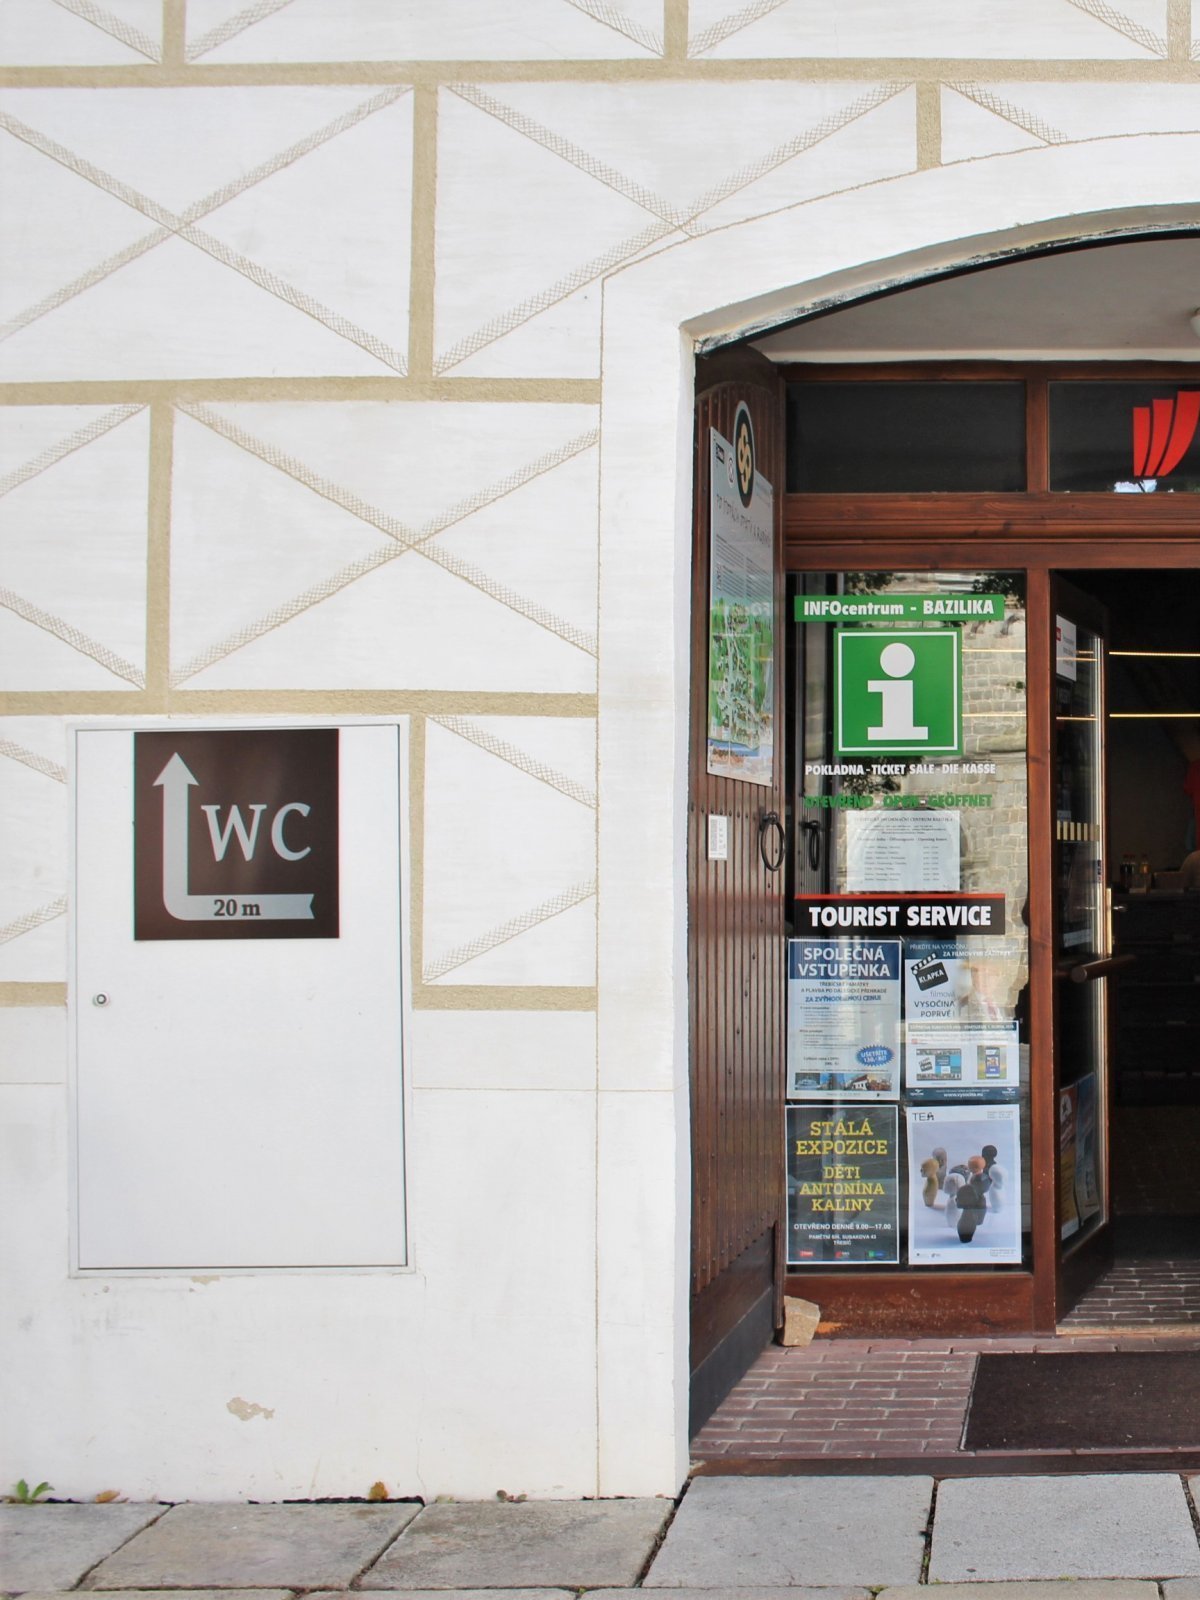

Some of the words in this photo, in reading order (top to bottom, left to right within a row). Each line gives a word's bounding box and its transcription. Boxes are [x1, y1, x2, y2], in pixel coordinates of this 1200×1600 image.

[804, 600, 904, 615] INFOcentrum
[923, 600, 994, 614] BAZILIKA
[805, 764, 864, 776] POKLADNA
[871, 764, 906, 775] TICKET
[909, 764, 935, 775] SALE
[943, 764, 959, 774] DIE
[963, 763, 996, 774] KASSE
[200, 802, 311, 862] WC
[213, 898, 238, 917] 20
[242, 903, 261, 916] m
[809, 906, 899, 927] TOURIST
[907, 905, 991, 927] SERVICE
[804, 945, 885, 961] SPOLEČNÁ
[798, 963, 890, 977] VSTUPENKA
[918, 969, 945, 984] KLAPKA
[810, 1118, 873, 1136] STÁLÁ
[796, 1140, 888, 1155] EXPOZICE
[823, 1164, 860, 1179] DĚTI
[800, 1181, 885, 1195] ANTONÍNA
[811, 1198, 874, 1212] KALINY
